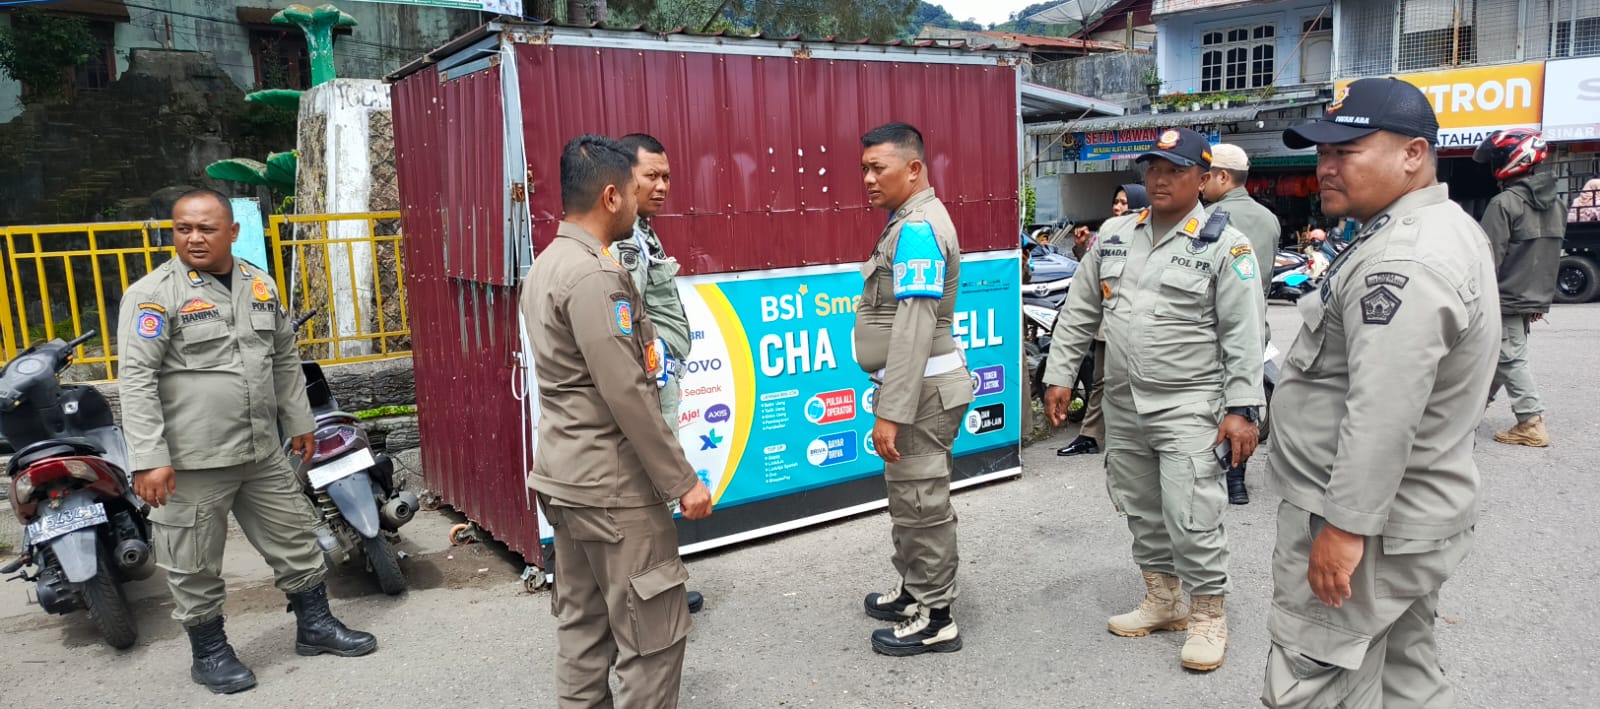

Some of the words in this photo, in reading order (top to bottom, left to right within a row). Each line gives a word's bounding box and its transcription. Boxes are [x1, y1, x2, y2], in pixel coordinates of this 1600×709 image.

[1420, 79, 1531, 113] TRON
[1086, 131, 1115, 145] SETIA
[1118, 127, 1157, 143] KAWAN
[1436, 131, 1492, 146] TAHA
[1547, 127, 1595, 139] SINAR
[1170, 256, 1191, 268] POL
[1195, 261, 1211, 271] PP
[894, 259, 946, 288] PTI
[252, 302, 266, 311] POL
[761, 292, 803, 323] BSI
[181, 309, 220, 324] HANIPAN
[759, 327, 837, 377] CHA
[687, 358, 722, 373] OVO
[684, 384, 722, 397] SeaBank
[826, 397, 843, 407] PULSA
[843, 395, 853, 404] ALL
[708, 409, 728, 419] AXIS
[826, 404, 853, 417] OPERATOR
